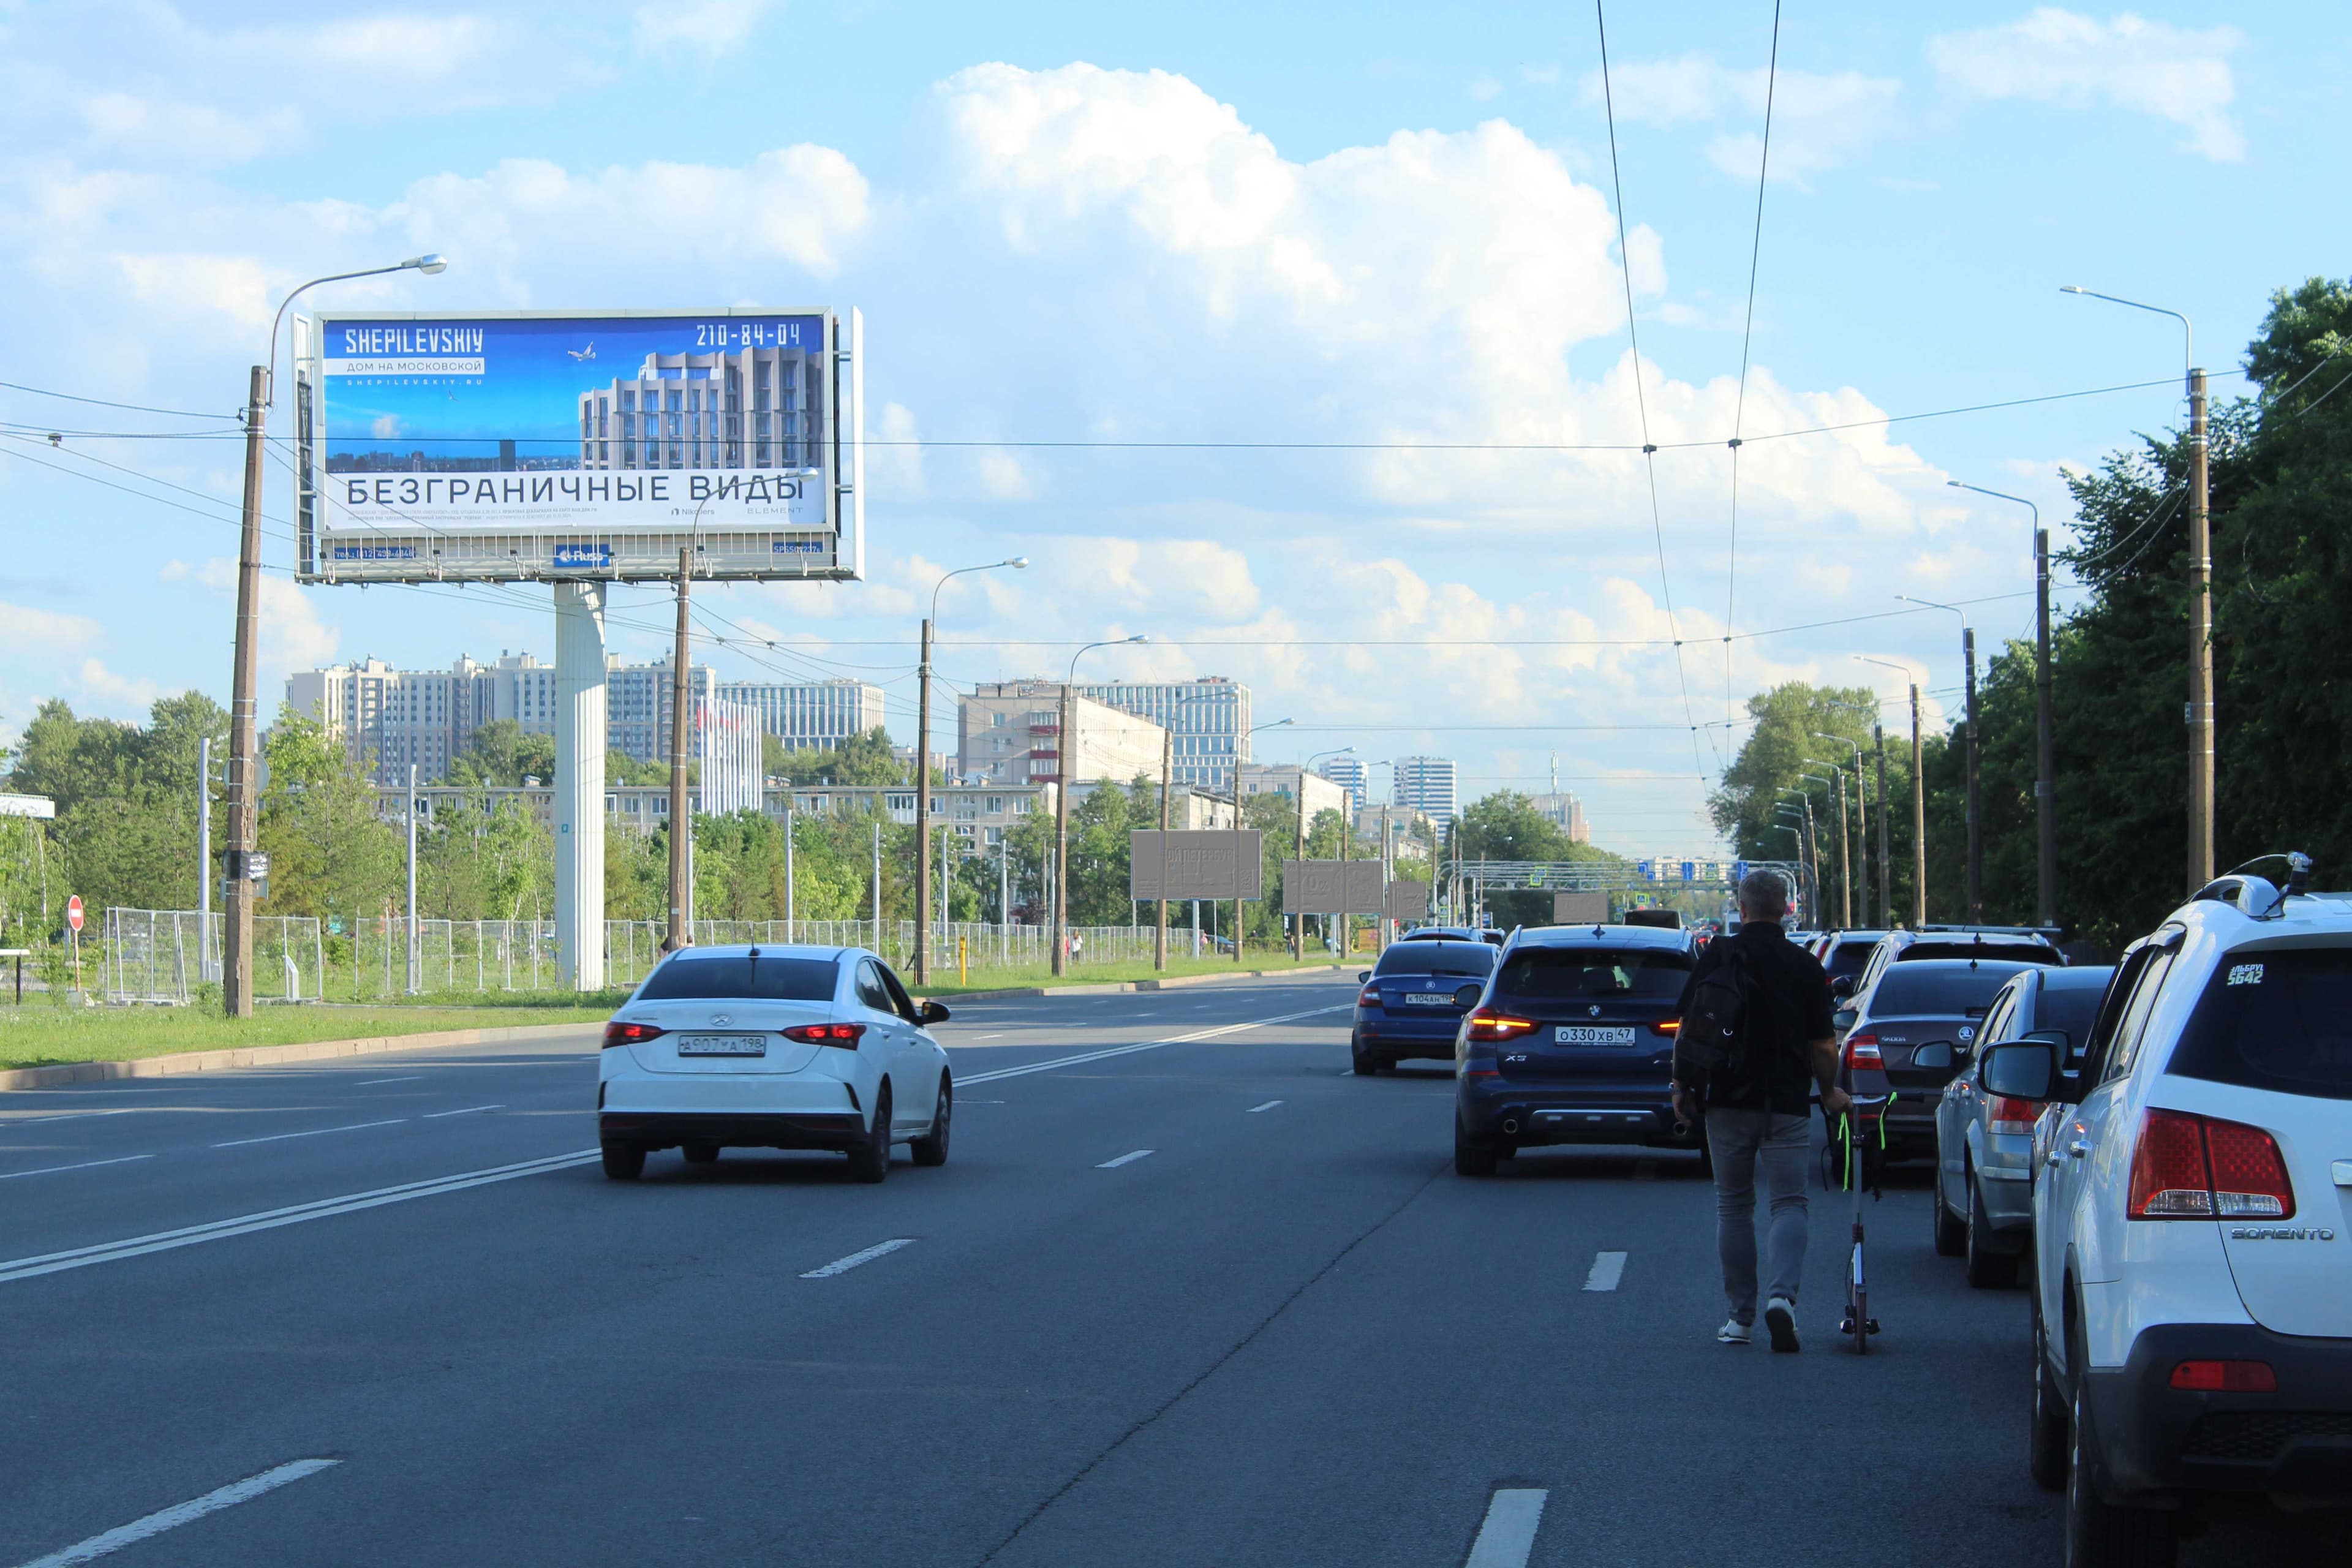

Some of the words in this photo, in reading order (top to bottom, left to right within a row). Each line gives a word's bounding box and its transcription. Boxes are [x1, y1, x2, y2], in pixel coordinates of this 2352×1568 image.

[345, 328, 484, 353] SHEPILEVSKIY
[697, 323, 801, 346] 210-84-04
[347, 362, 374, 373] ДОМ
[379, 362, 394, 372] НА
[399, 360, 481, 372] МОСКОВСКОЙ
[348, 475, 669, 505] БЕЗГРАНИЧНЫЕ
[690, 475, 803, 505] ВИДЫ
[2227, 971, 2264, 986] 5642
[2230, 1226, 2335, 1242] SORENTO
